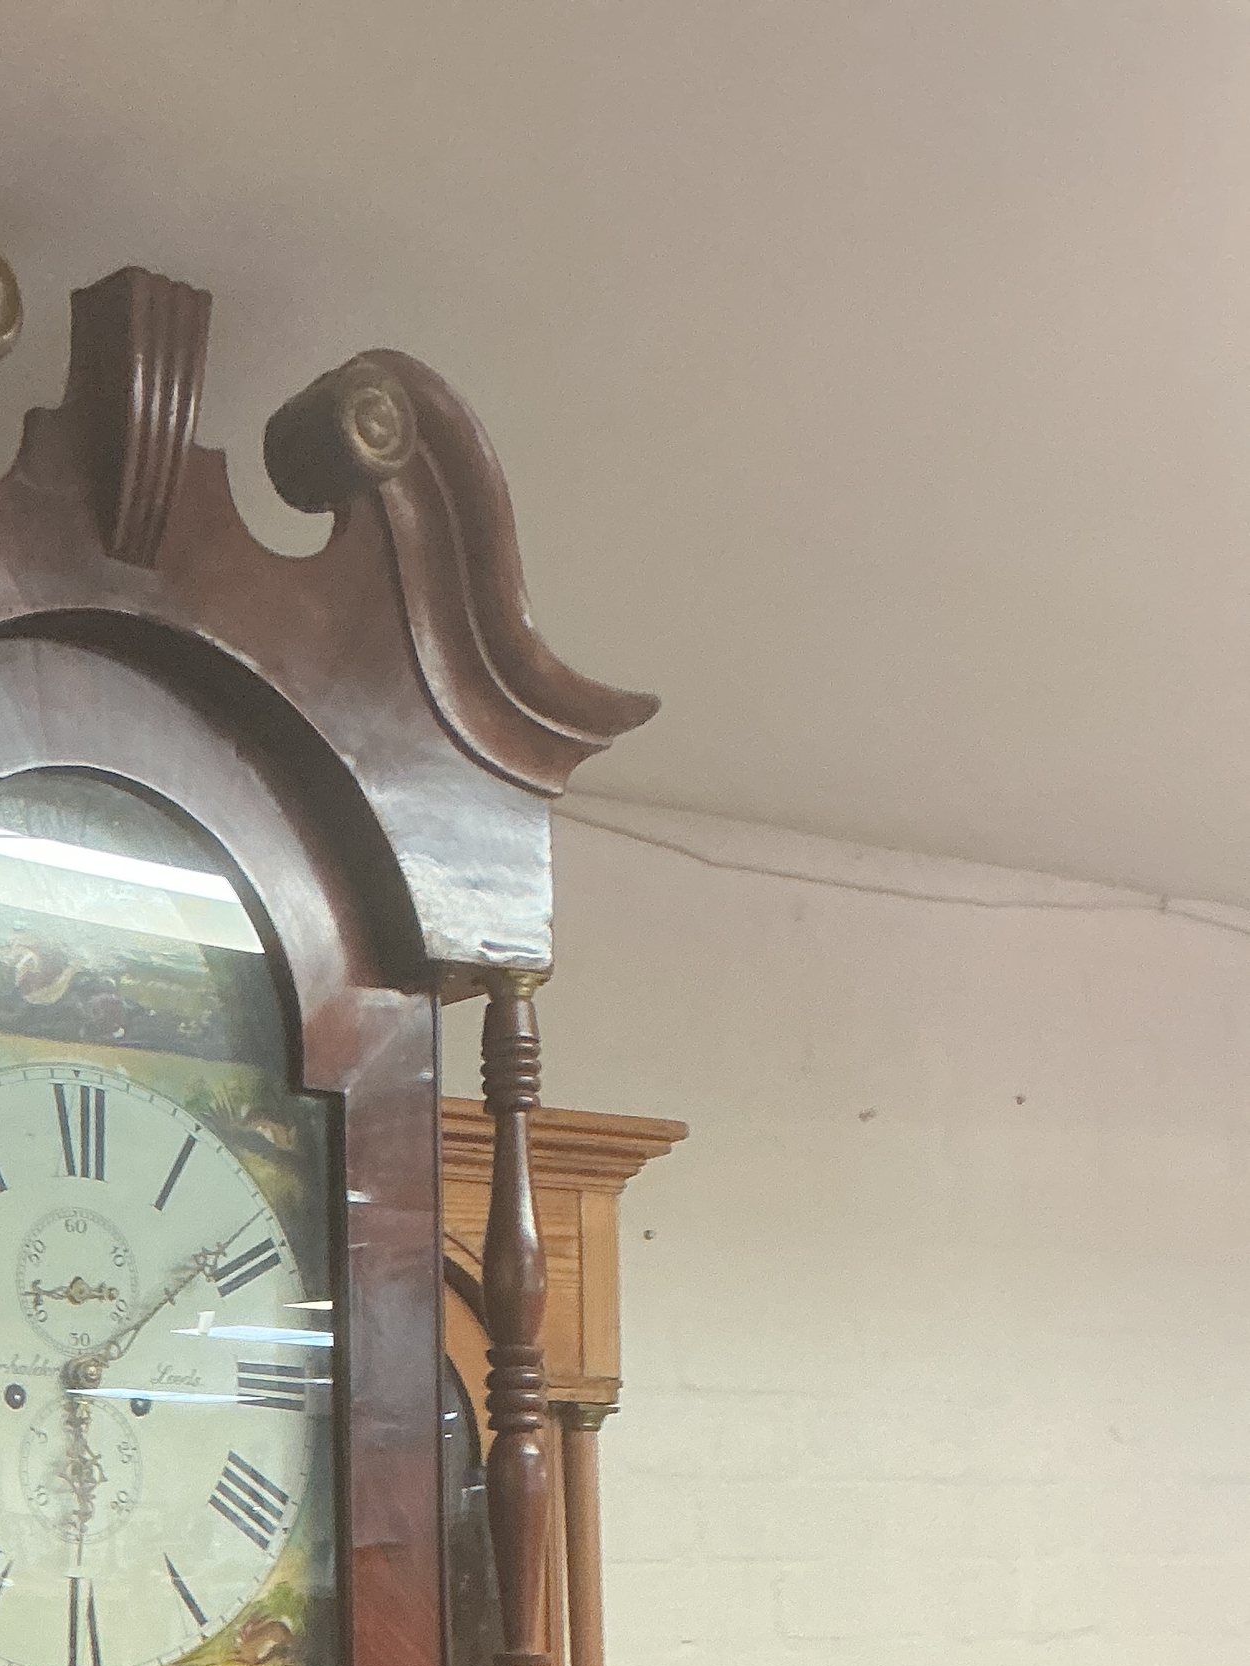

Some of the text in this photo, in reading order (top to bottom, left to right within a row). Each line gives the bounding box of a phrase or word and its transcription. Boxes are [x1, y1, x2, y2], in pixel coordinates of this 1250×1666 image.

[52, 1083, 106, 1182] XII
[151, 1131, 198, 1212] I
[64, 1218, 88, 1234] 60
[213, 1237, 282, 1298] II
[236, 1359, 306, 1412] III
[209, 1450, 290, 1551] IIII
